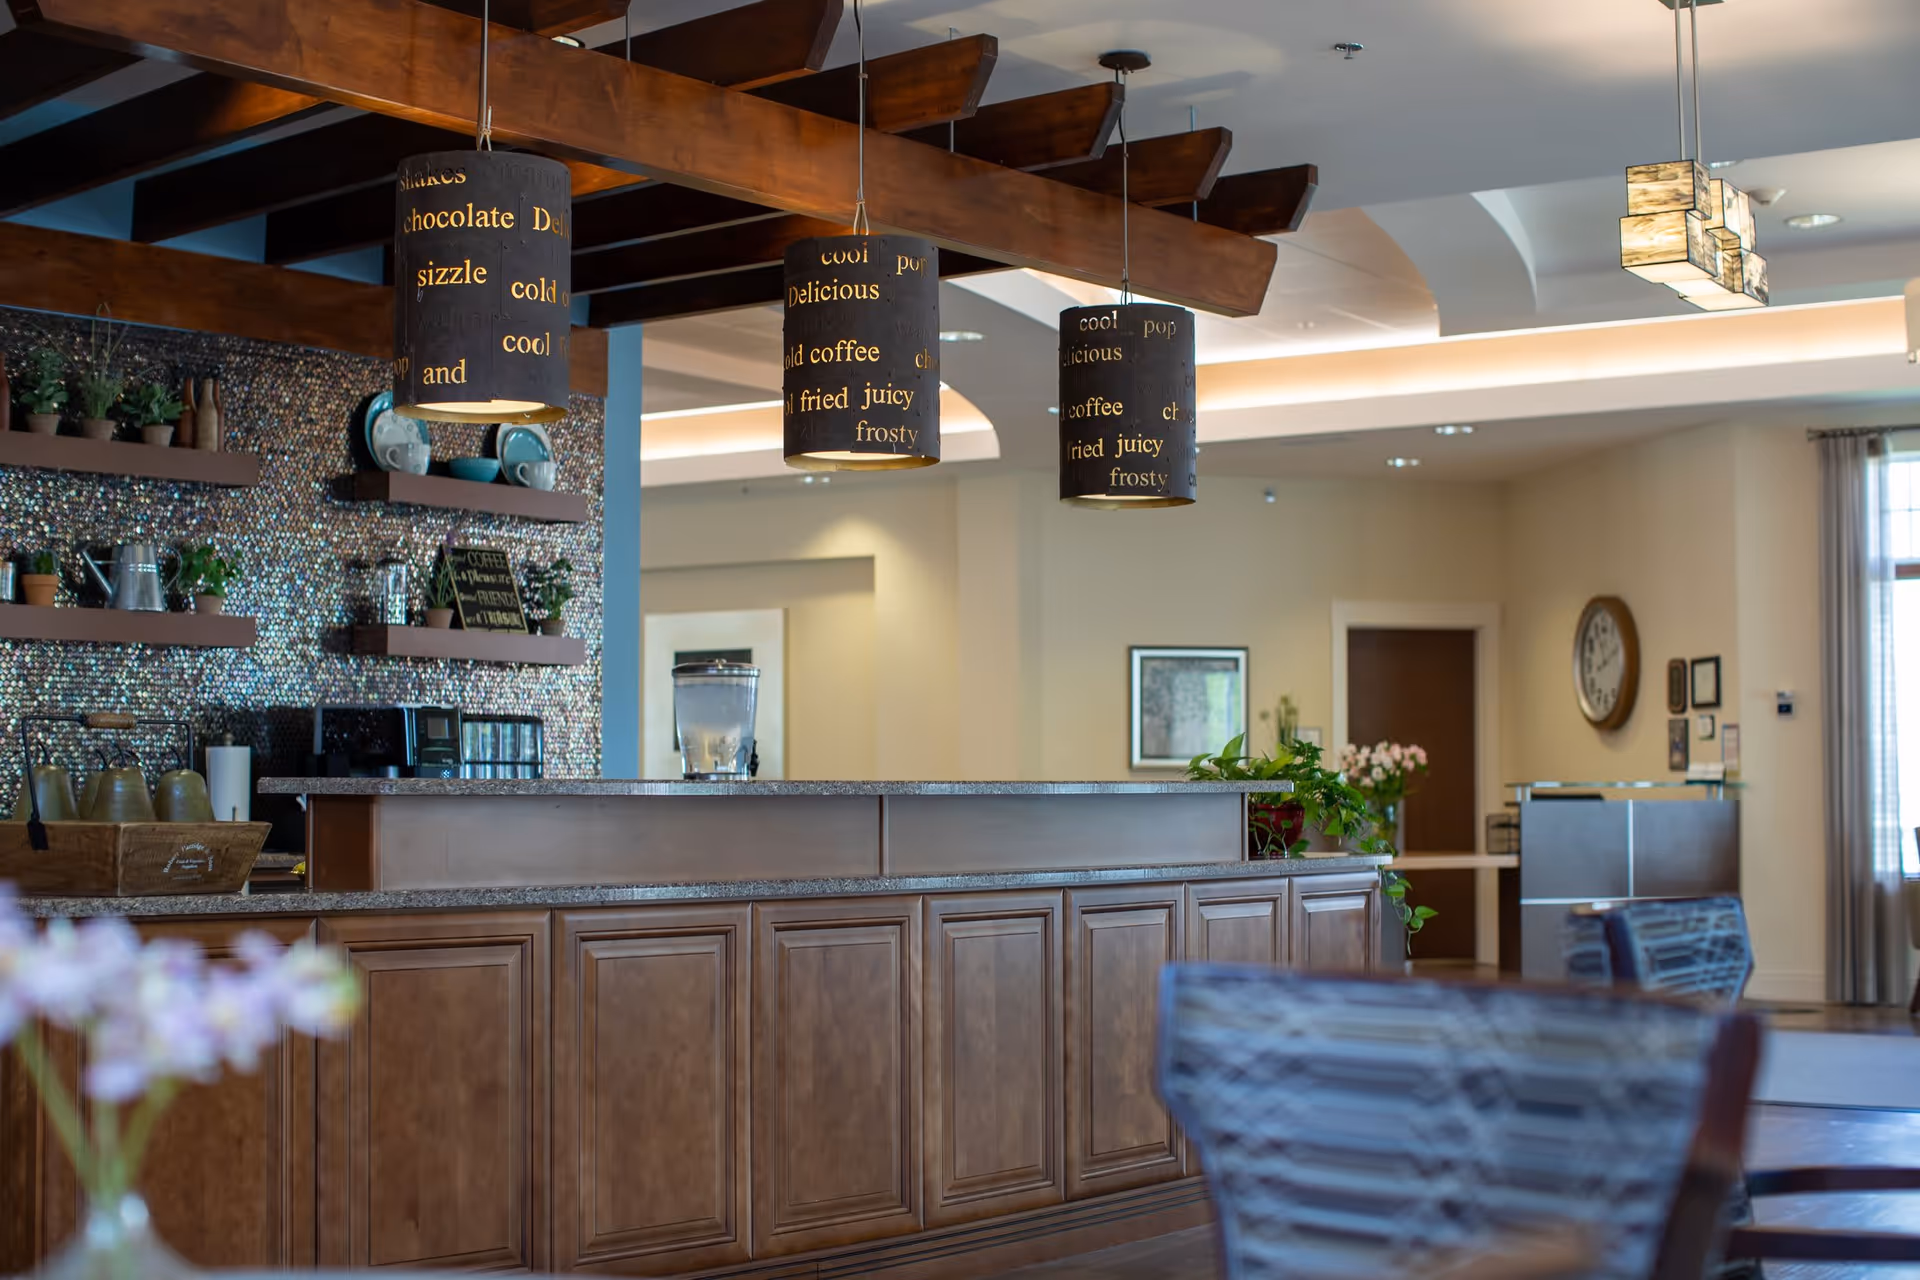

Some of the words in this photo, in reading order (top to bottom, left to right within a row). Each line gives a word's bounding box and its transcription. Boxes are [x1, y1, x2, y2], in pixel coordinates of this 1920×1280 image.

[404, 203, 515, 234] chocolate
[821, 242, 869, 266] cool
[417, 259, 488, 287] sizzle
[511, 277, 557, 304] cold
[788, 279, 880, 307] Delicious
[1079, 310, 1118, 332] cool
[1143, 319, 1177, 340] pop
[502, 332, 550, 356] cool
[810, 339, 880, 364] coffee
[422, 358, 468, 385] and
[800, 386, 849, 412] fried
[860, 382, 915, 411] juicy
[1069, 397, 1124, 418] coffee
[855, 420, 920, 449] frosty
[1115, 433, 1163, 459] juicy
[1109, 467, 1168, 492] frosty
[467, 551, 507, 569] COFFEE
